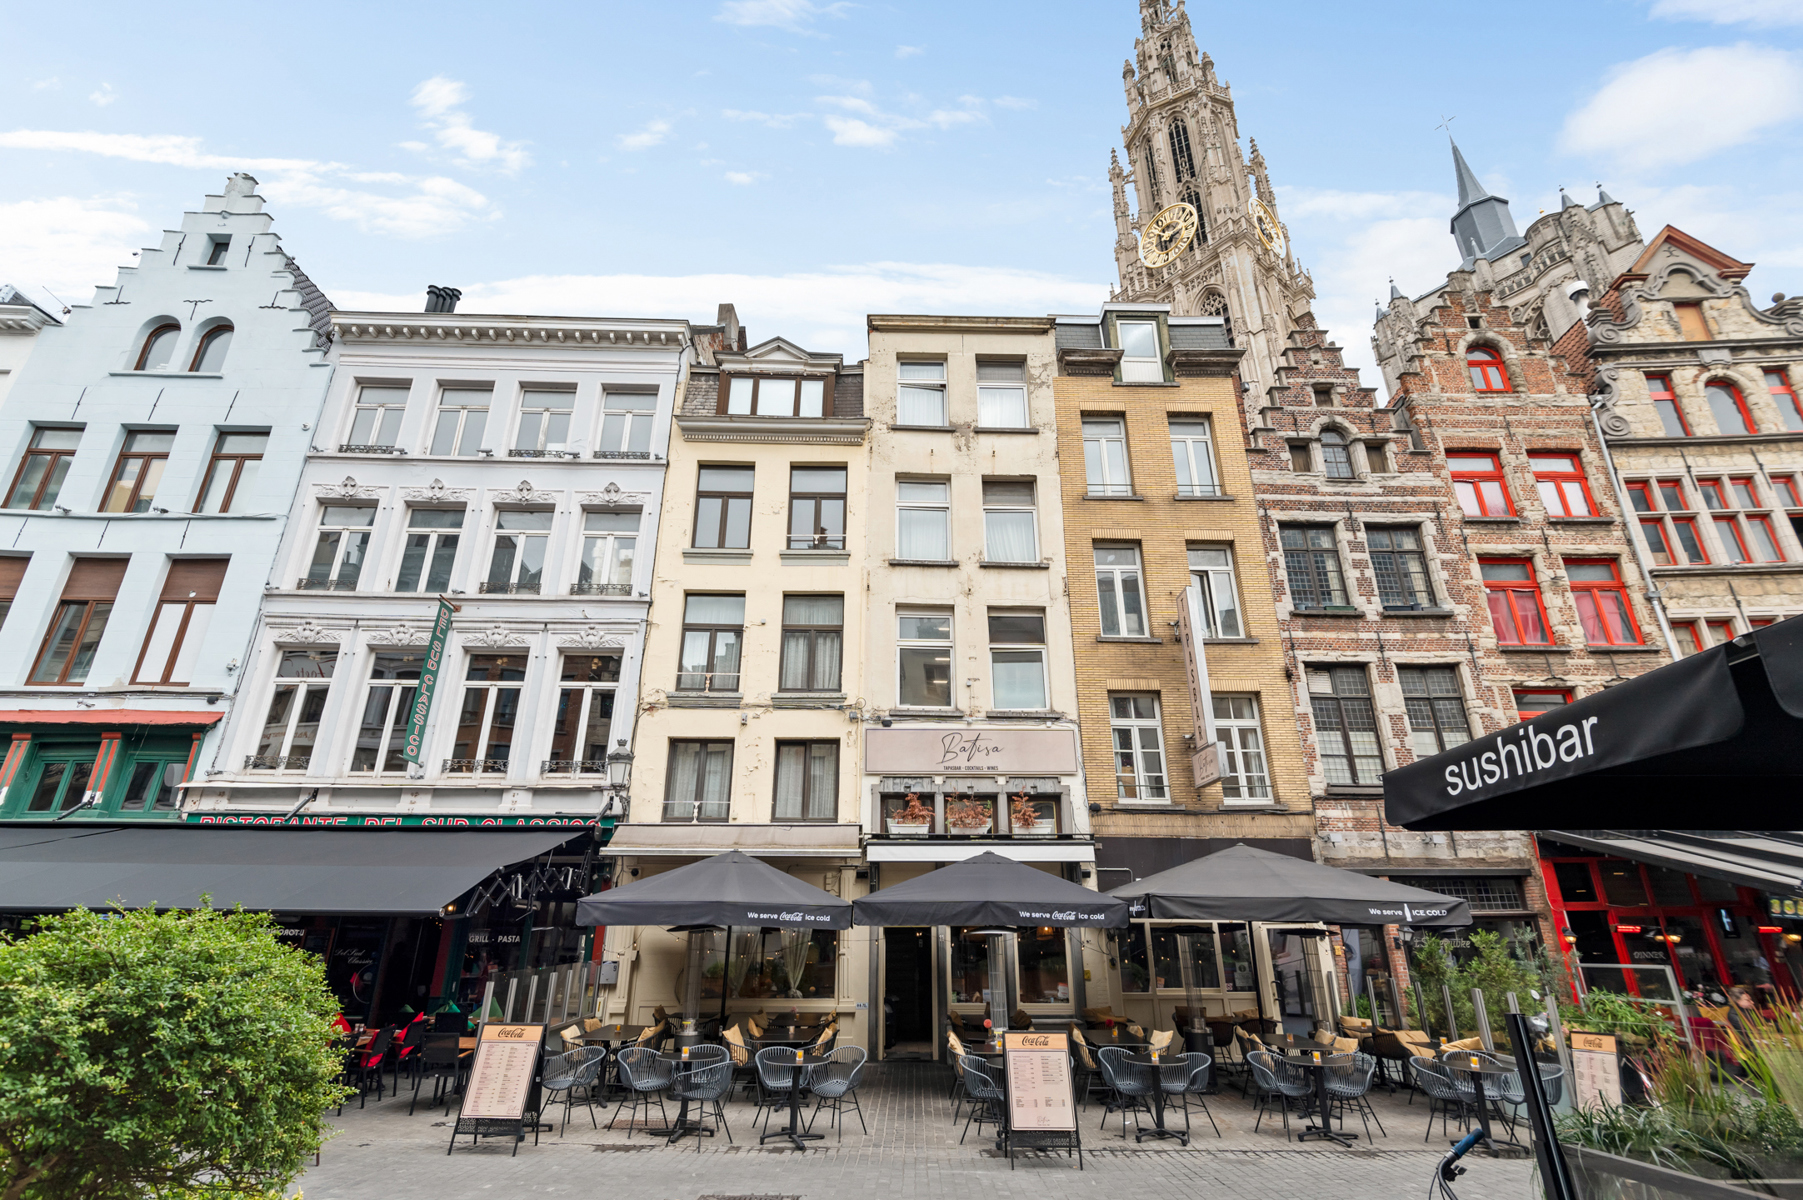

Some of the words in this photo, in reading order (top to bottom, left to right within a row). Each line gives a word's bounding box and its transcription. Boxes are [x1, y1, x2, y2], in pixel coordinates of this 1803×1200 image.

[436, 607, 450, 639] DEL
[427, 640, 442, 671] SUD
[1180, 598, 1203, 741] TAPASBAR
[407, 675, 434, 756] CLASSICO
[936, 732, 1005, 765] Batisa
[1445, 715, 1598, 796] sushibar
[759, 912, 778, 920] serve
[816, 914, 831, 922] cold
[1019, 910, 1031, 918] We
[1031, 911, 1051, 919] serve
[1089, 912, 1105, 920] cold
[468, 935, 489, 943] GRILL
[497, 935, 521, 943] PASTA
